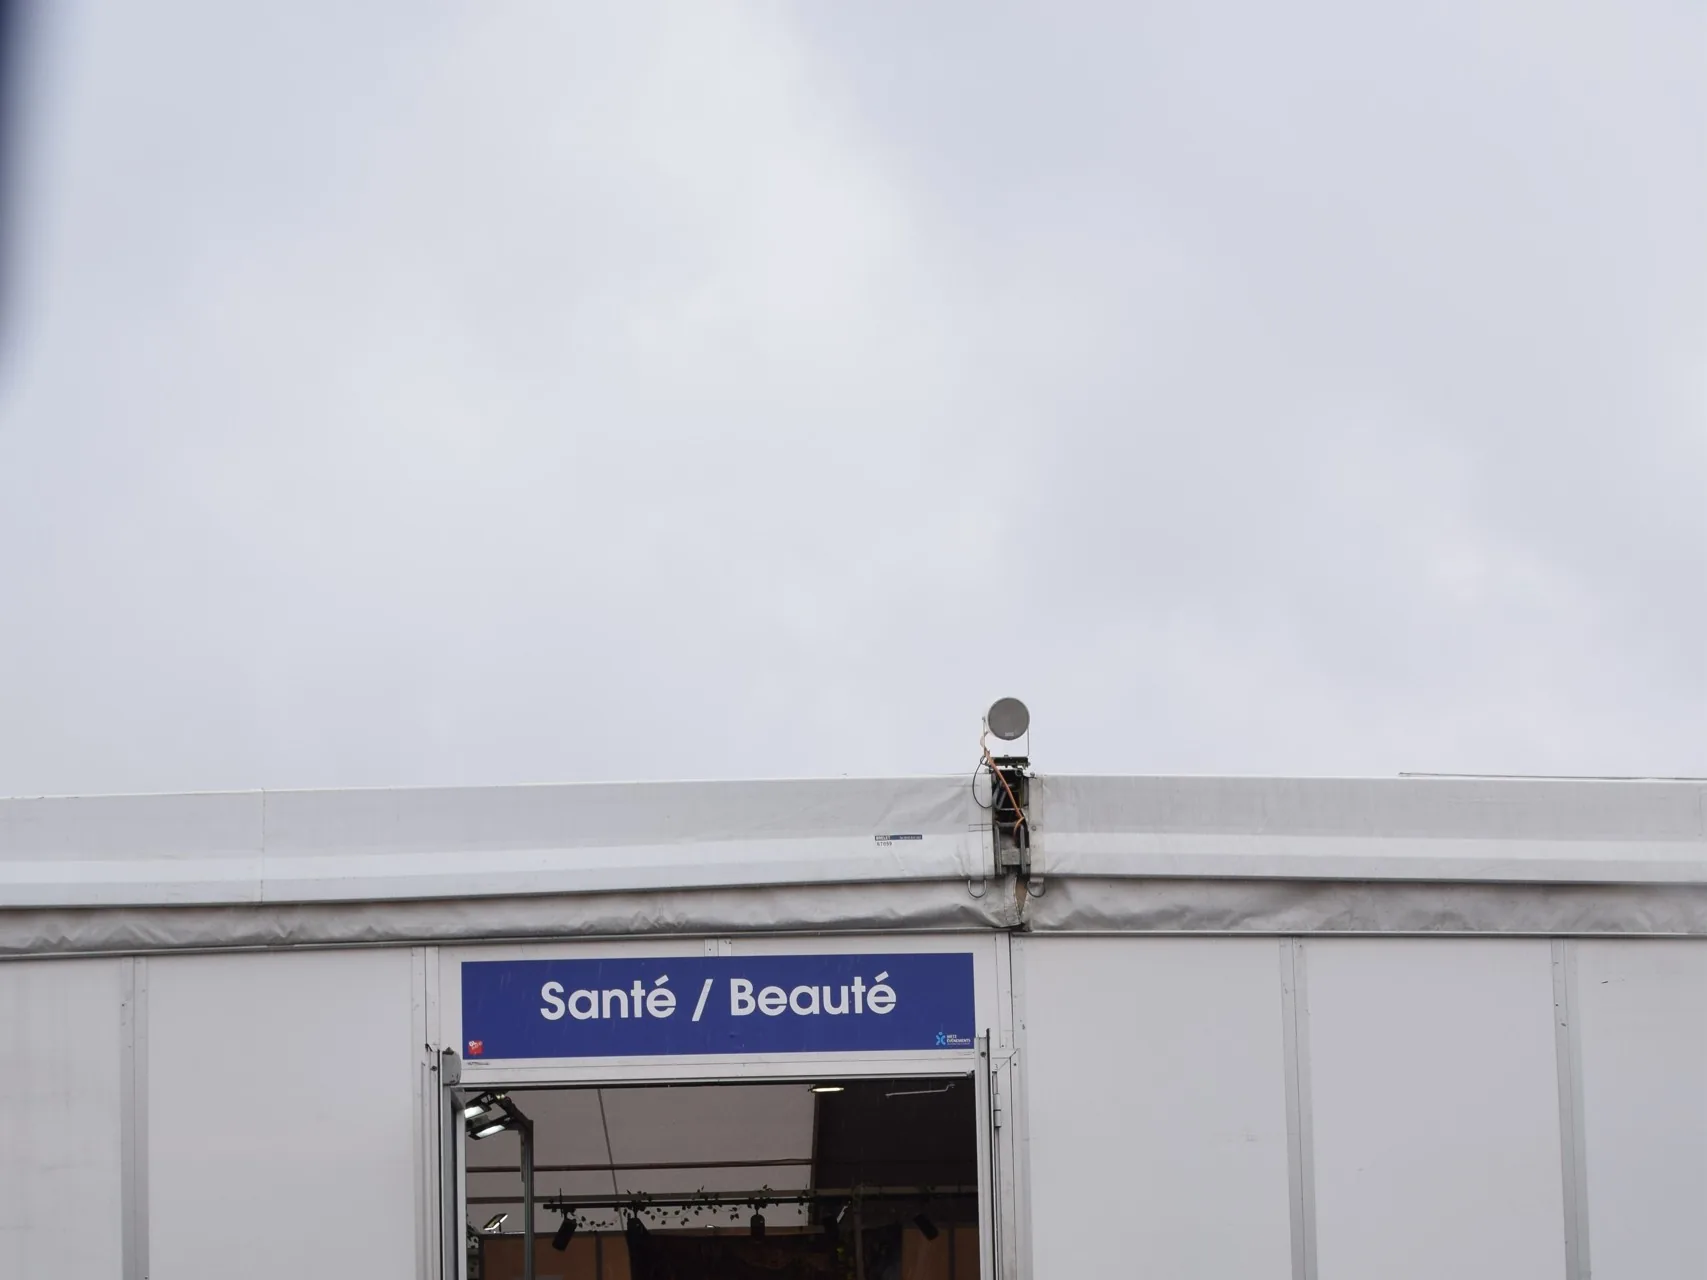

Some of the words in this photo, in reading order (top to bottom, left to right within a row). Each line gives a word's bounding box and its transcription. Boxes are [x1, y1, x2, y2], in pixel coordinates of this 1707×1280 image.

[541, 975, 676, 1020] Santé
[692, 979, 713, 1021] /
[731, 971, 896, 1015] Beauté
